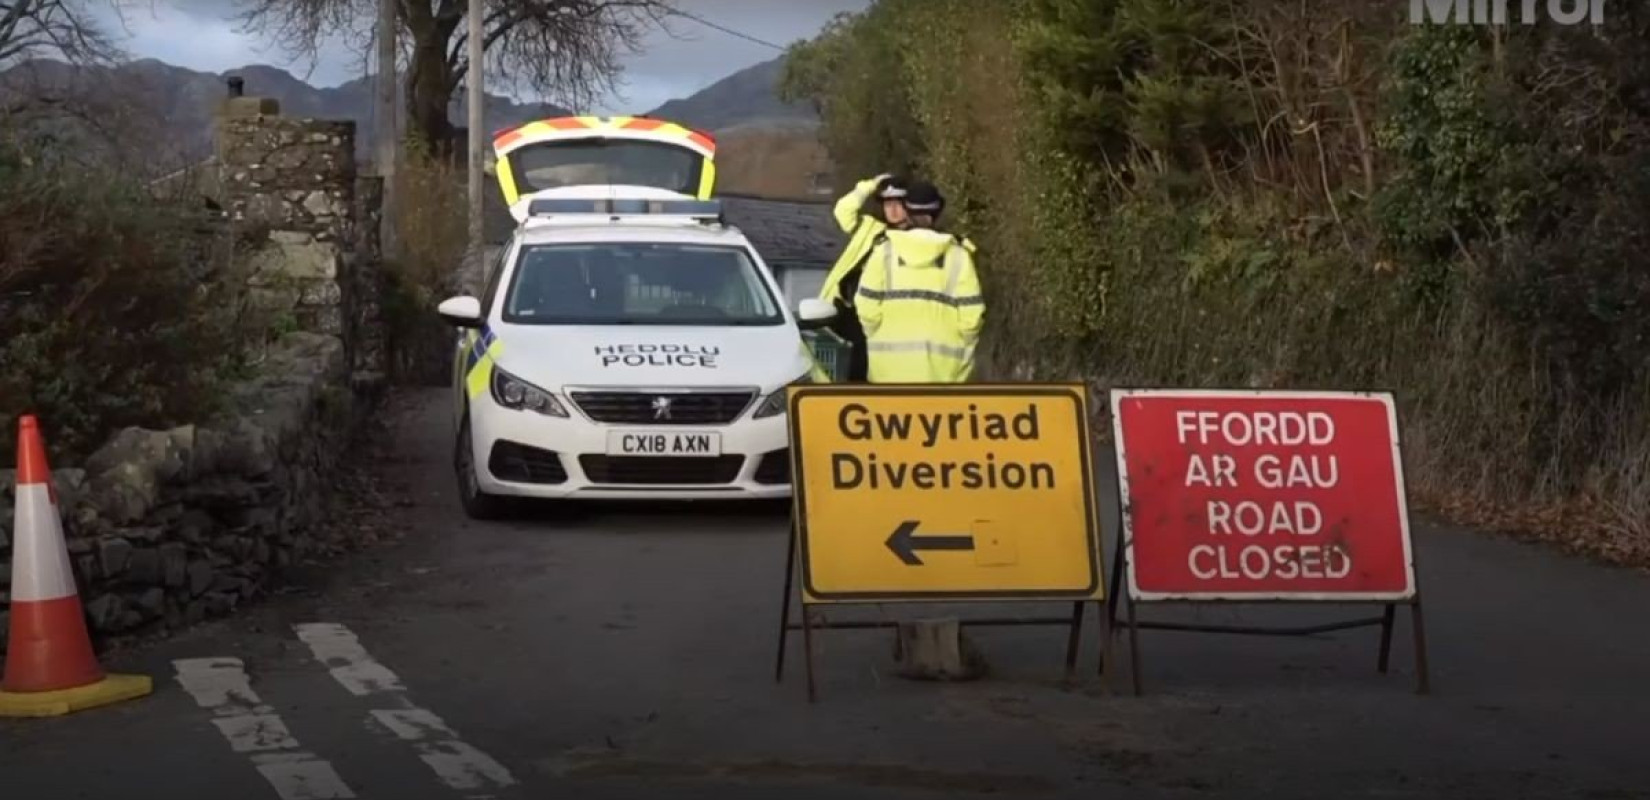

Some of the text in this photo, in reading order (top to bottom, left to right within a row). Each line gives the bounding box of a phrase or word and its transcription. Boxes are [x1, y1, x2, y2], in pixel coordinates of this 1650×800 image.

[594, 344, 720, 355] HEDDLU
[602, 354, 717, 367] POLICE
[838, 403, 1039, 447] Gwyriad
[1176, 411, 1334, 445] FFORDD
[623, 435, 709, 453] CX18 AXN
[832, 453, 1055, 490] Diversion
[1185, 454, 1338, 488] AR GAU
[1207, 501, 1322, 534] ROAD
[1188, 545, 1350, 579] CLOSED
